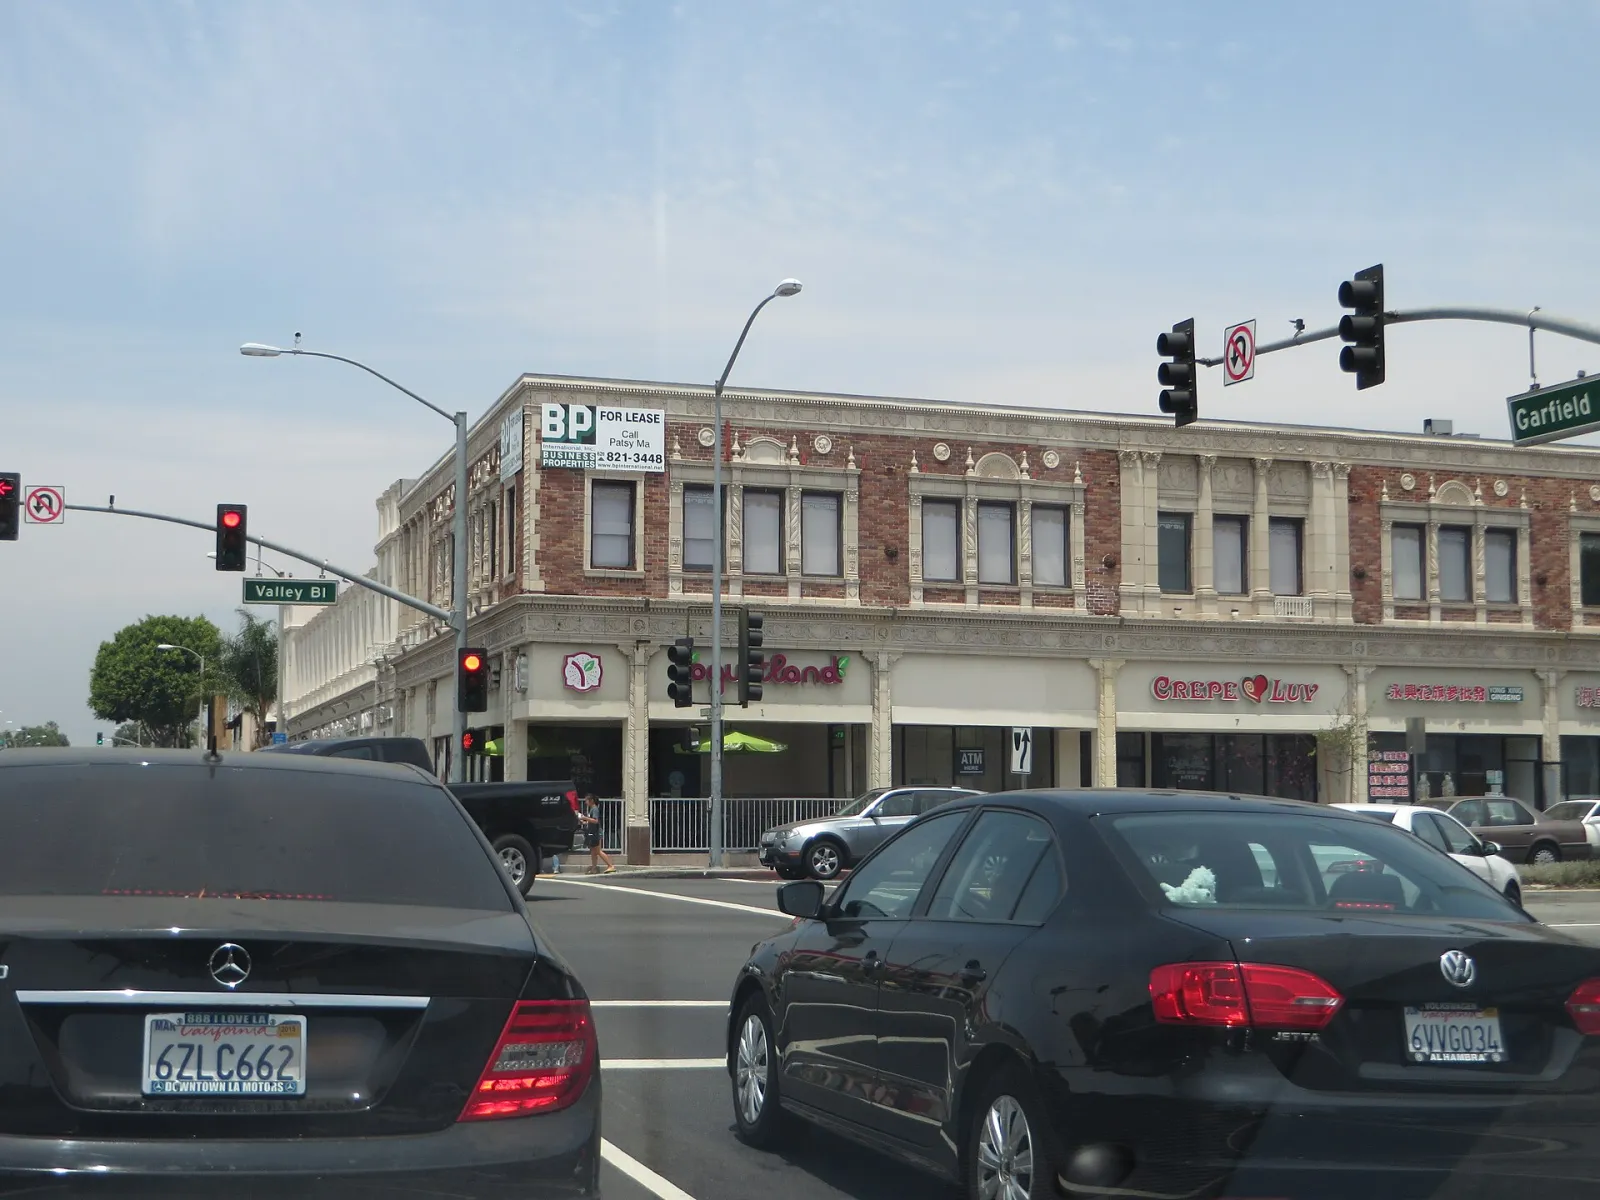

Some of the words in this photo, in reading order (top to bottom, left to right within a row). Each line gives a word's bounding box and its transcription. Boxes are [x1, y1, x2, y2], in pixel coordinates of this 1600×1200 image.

[600, 411, 622, 422] FOR
[626, 412, 661, 424] LEASE
[1516, 392, 1591, 431] Garfield
[542, 403, 593, 441] BP
[621, 430, 639, 439] Call
[609, 438, 634, 449] Patsy
[636, 439, 651, 448] Ma
[543, 451, 595, 461] BUSINESS
[606, 451, 663, 464] 821-3448
[543, 459, 595, 468] PROPERTIES
[256, 585, 304, 601] Valley
[310, 586, 326, 598] Bl
[1153, 675, 1239, 701] CREPE
[1268, 679, 1319, 703] LUV
[1235, 718, 1240, 727] 7
[961, 753, 983, 765] ATM
[187, 1014, 210, 1024] 888
[221, 1014, 250, 1024] LOVE
[252, 1014, 267, 1024] LA
[180, 1025, 274, 1042] California
[1272, 1031, 1320, 1042] JETTA
[1411, 1023, 1498, 1052] 6VVG034
[155, 1043, 295, 1081] 6ZLC662
[1429, 1053, 1485, 1061] ALHAMBRA
[165, 1081, 226, 1092] DOWNTOWN
[228, 1081, 241, 1092] LA
[243, 1081, 284, 1092] MOTORS
